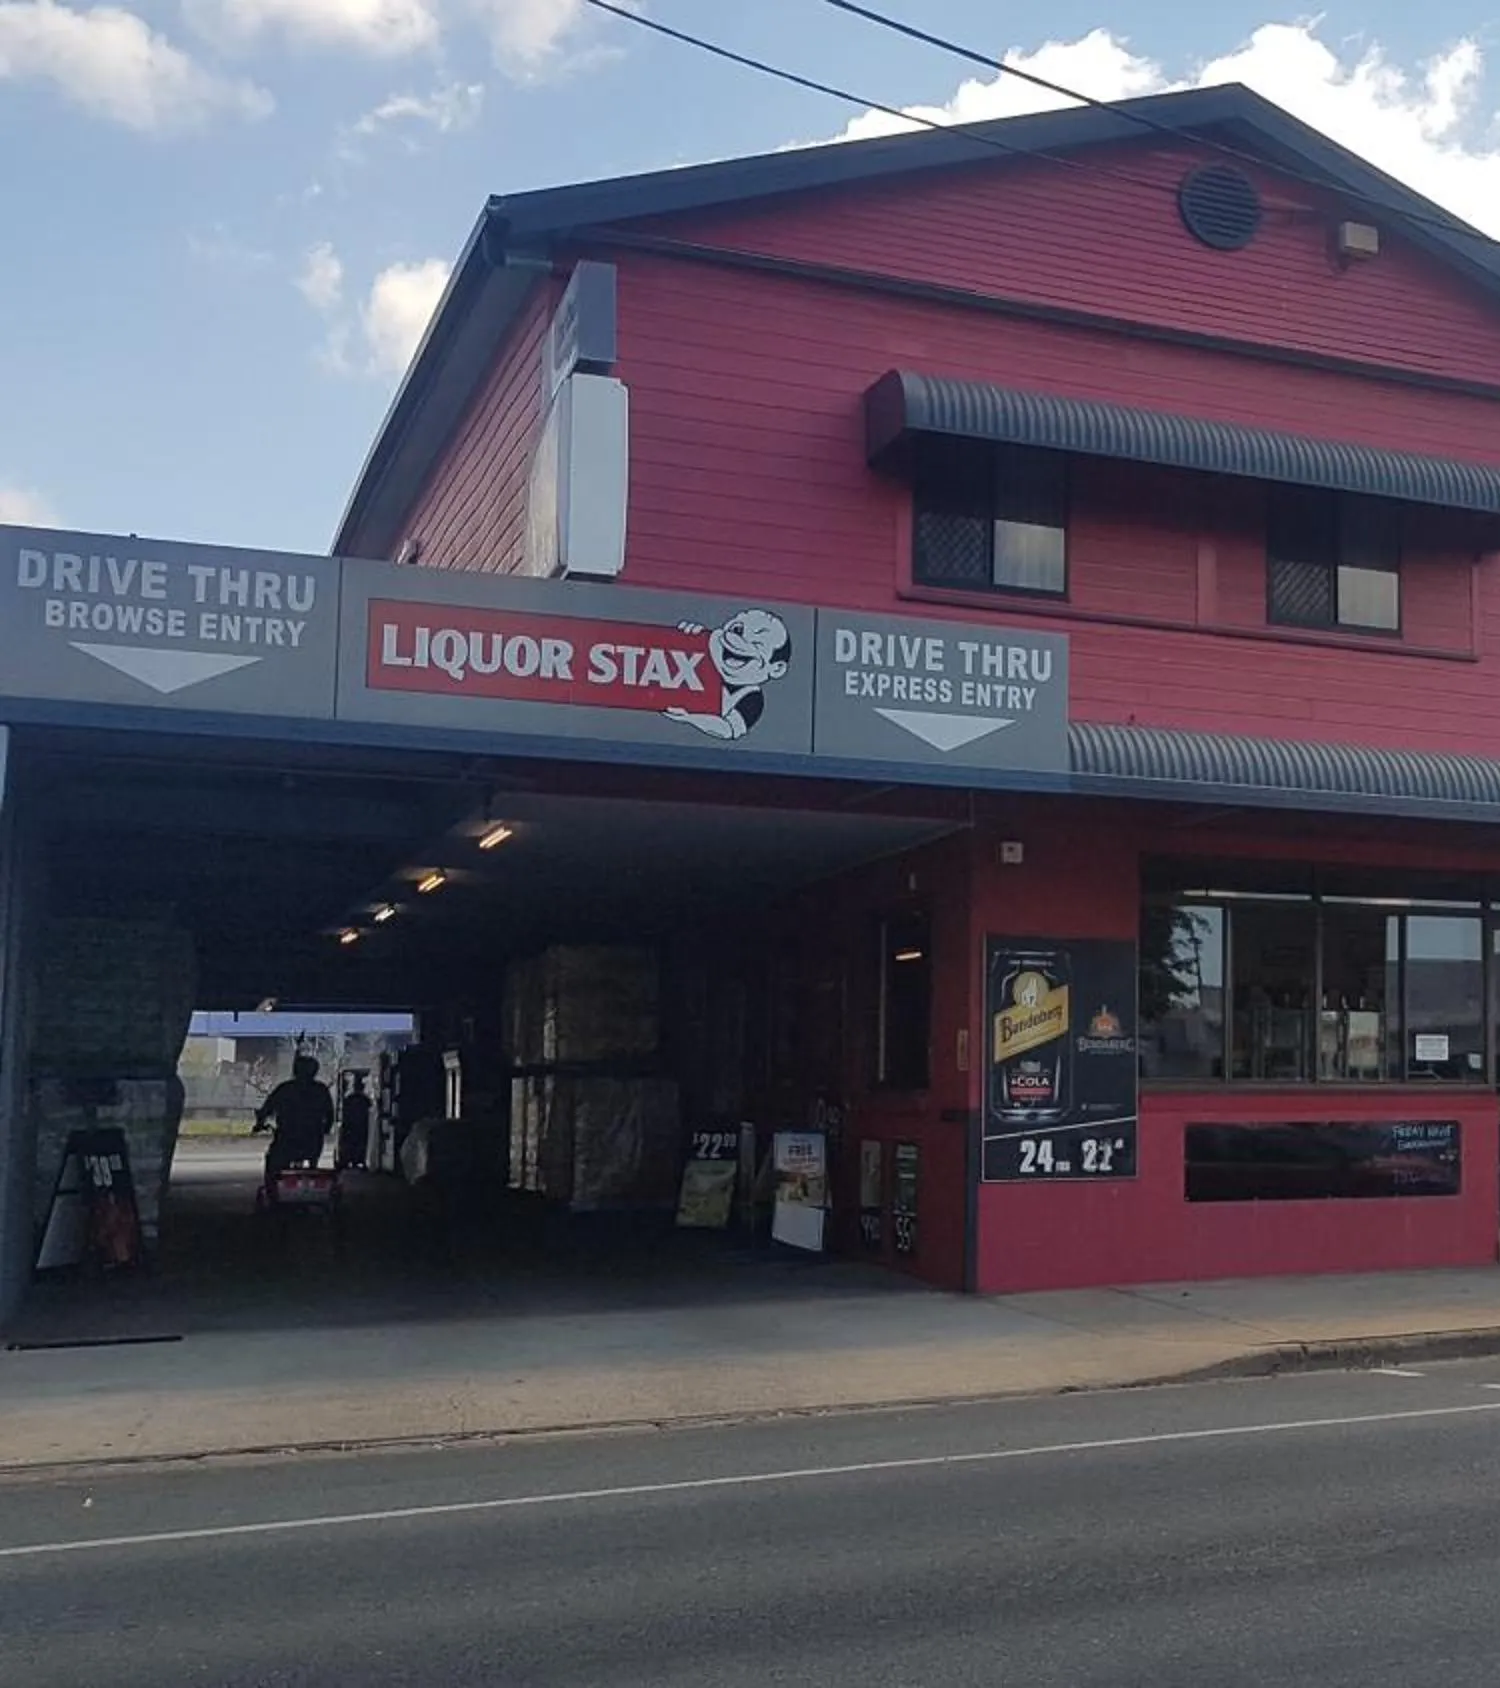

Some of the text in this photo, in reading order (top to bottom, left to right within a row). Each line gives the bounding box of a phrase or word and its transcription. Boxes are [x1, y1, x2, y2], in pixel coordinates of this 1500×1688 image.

[17, 548, 316, 612] DRIVE THRU
[45, 599, 306, 647] BROWSE ENTRY
[382, 623, 704, 691] LIQUOR STAX
[835, 629, 1052, 682] DRIVE THRU
[845, 670, 1036, 711] EXPRESS ENTRY
[1019, 1139, 1054, 1173] 24
